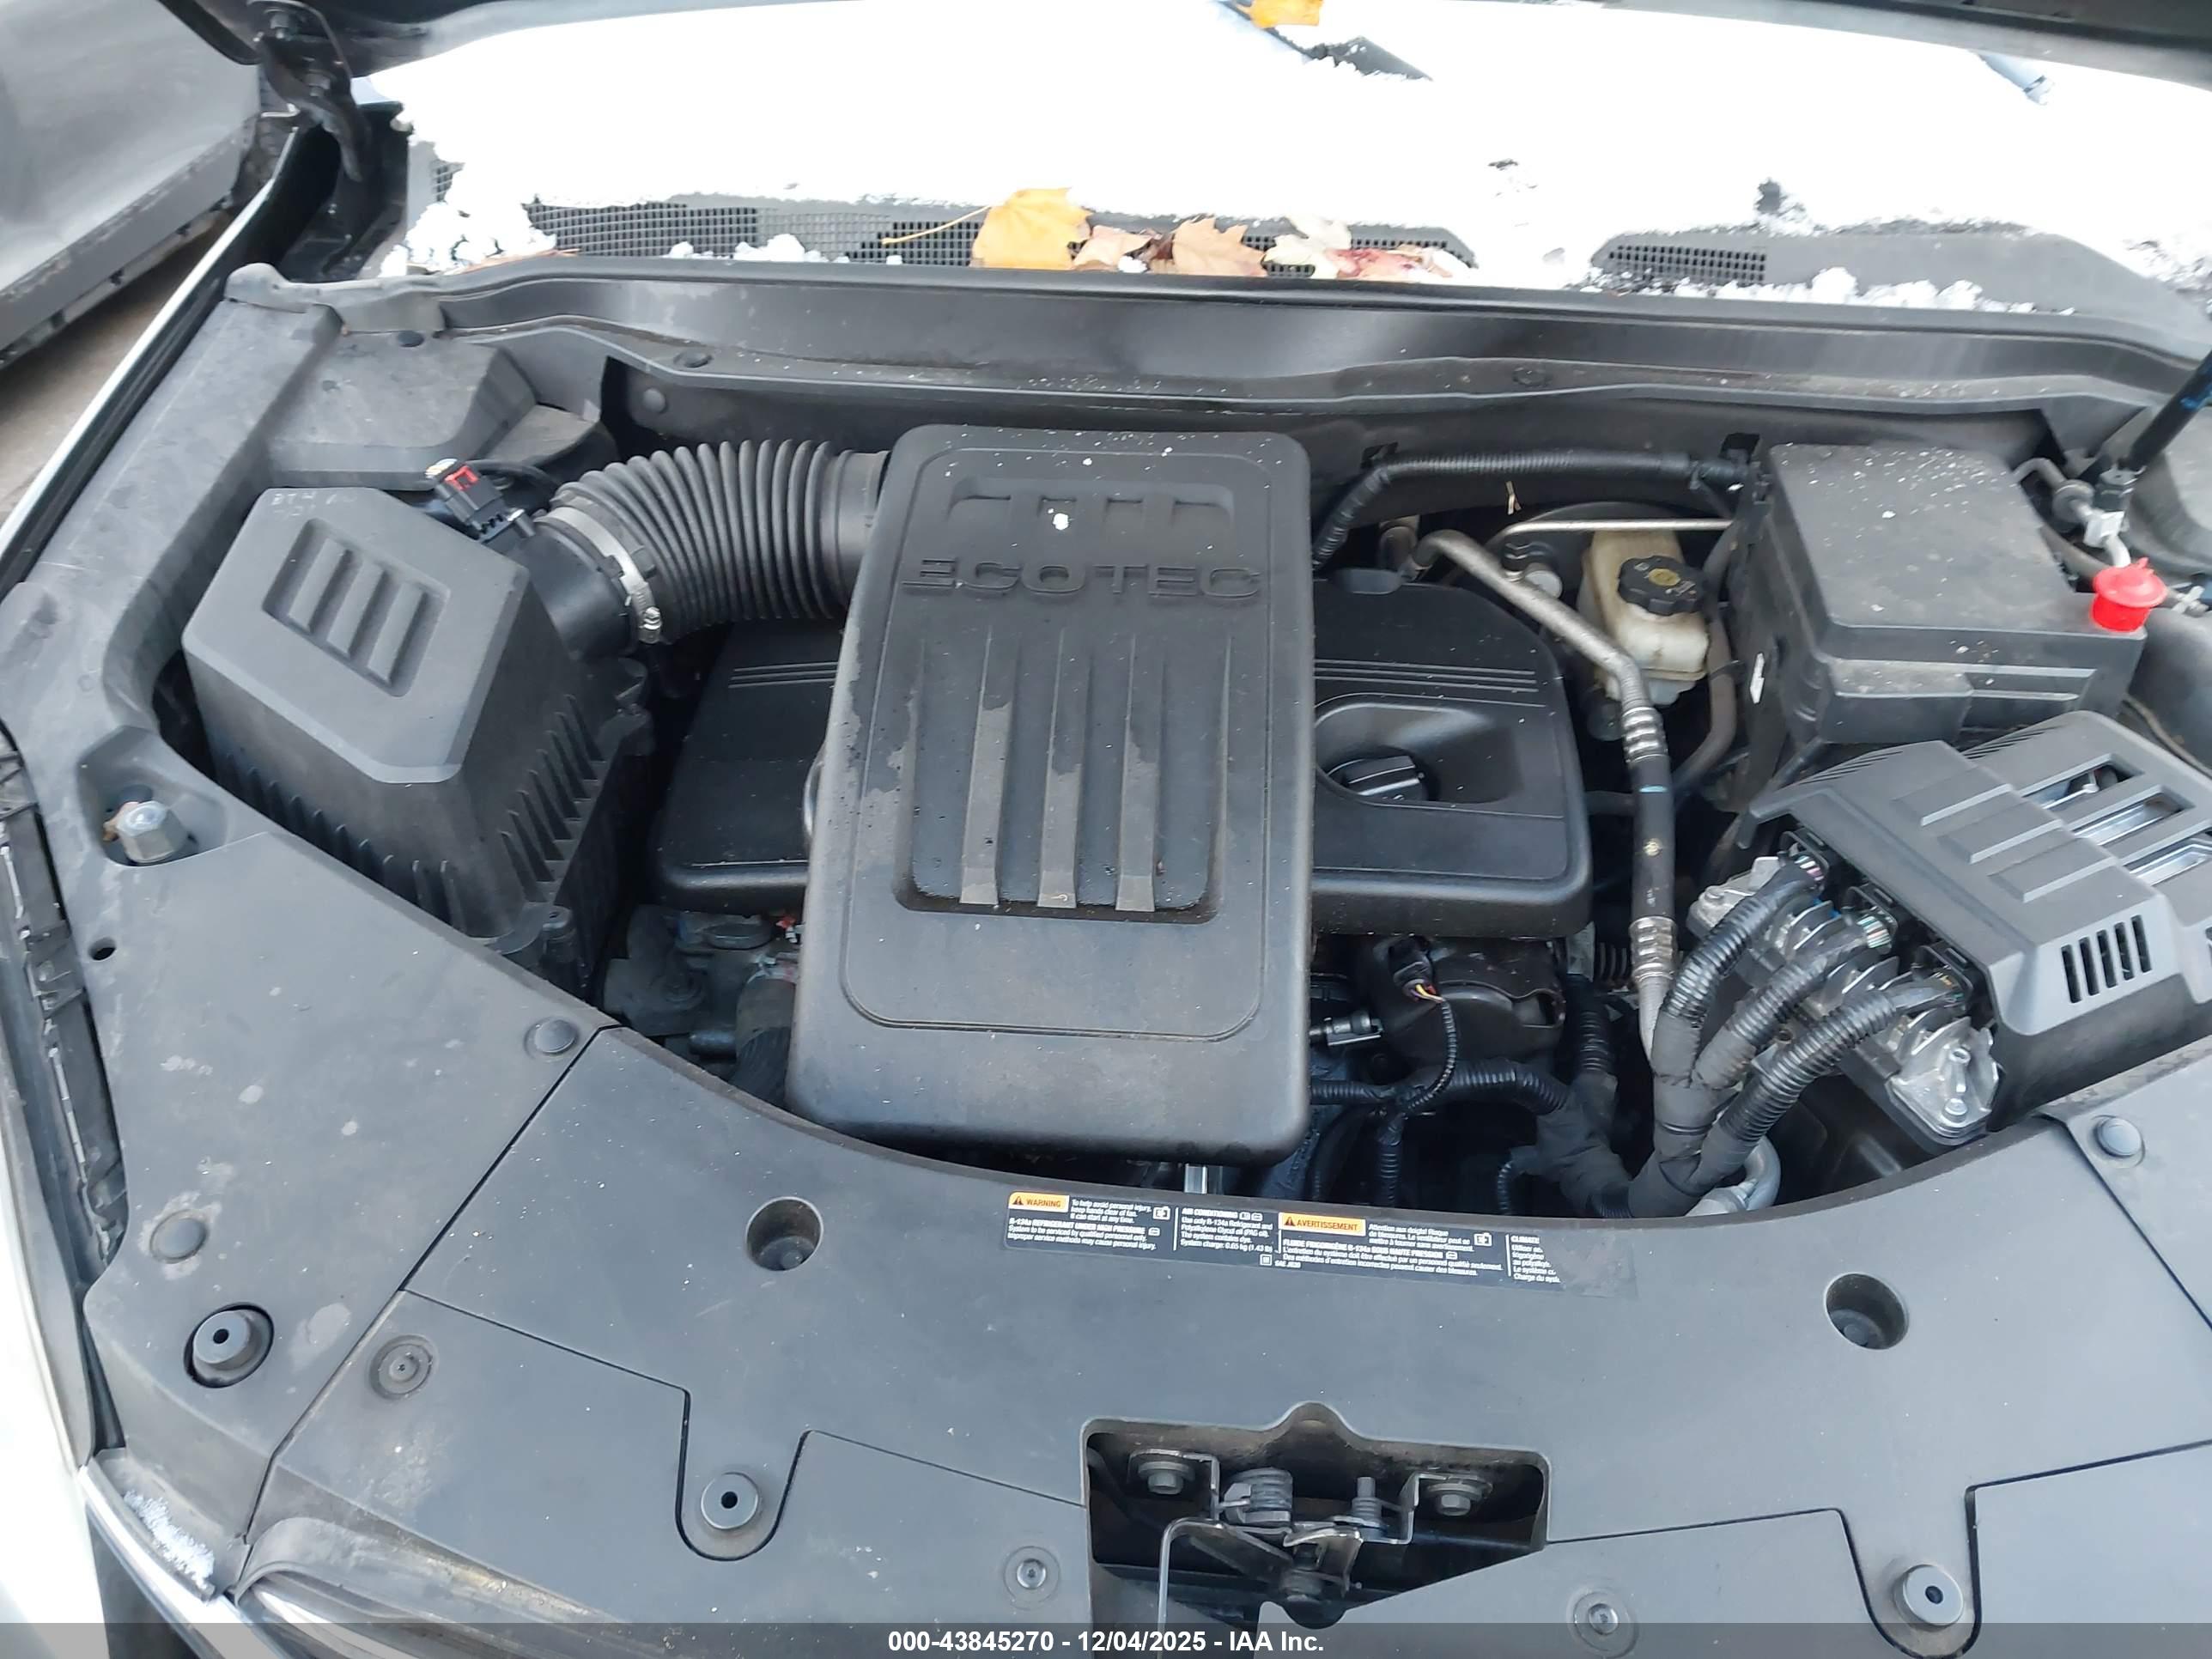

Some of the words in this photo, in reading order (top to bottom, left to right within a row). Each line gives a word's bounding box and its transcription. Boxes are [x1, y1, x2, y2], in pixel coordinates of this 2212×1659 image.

[902, 559, 1261, 599] ECOTEC
[1026, 1198, 1060, 1207] WARNING
[1134, 1204, 1152, 1212] injury.
[1194, 1209, 1237, 1218] CONDITIONING
[1113, 1225, 1146, 1234] PRESSURE
[1229, 1220, 1261, 1230] Refrigerant
[1297, 1219, 1358, 1231] AVERTISSEMENT
[1369, 1224, 1395, 1232] Attention
[1514, 1273, 1535, 1282] Charge
